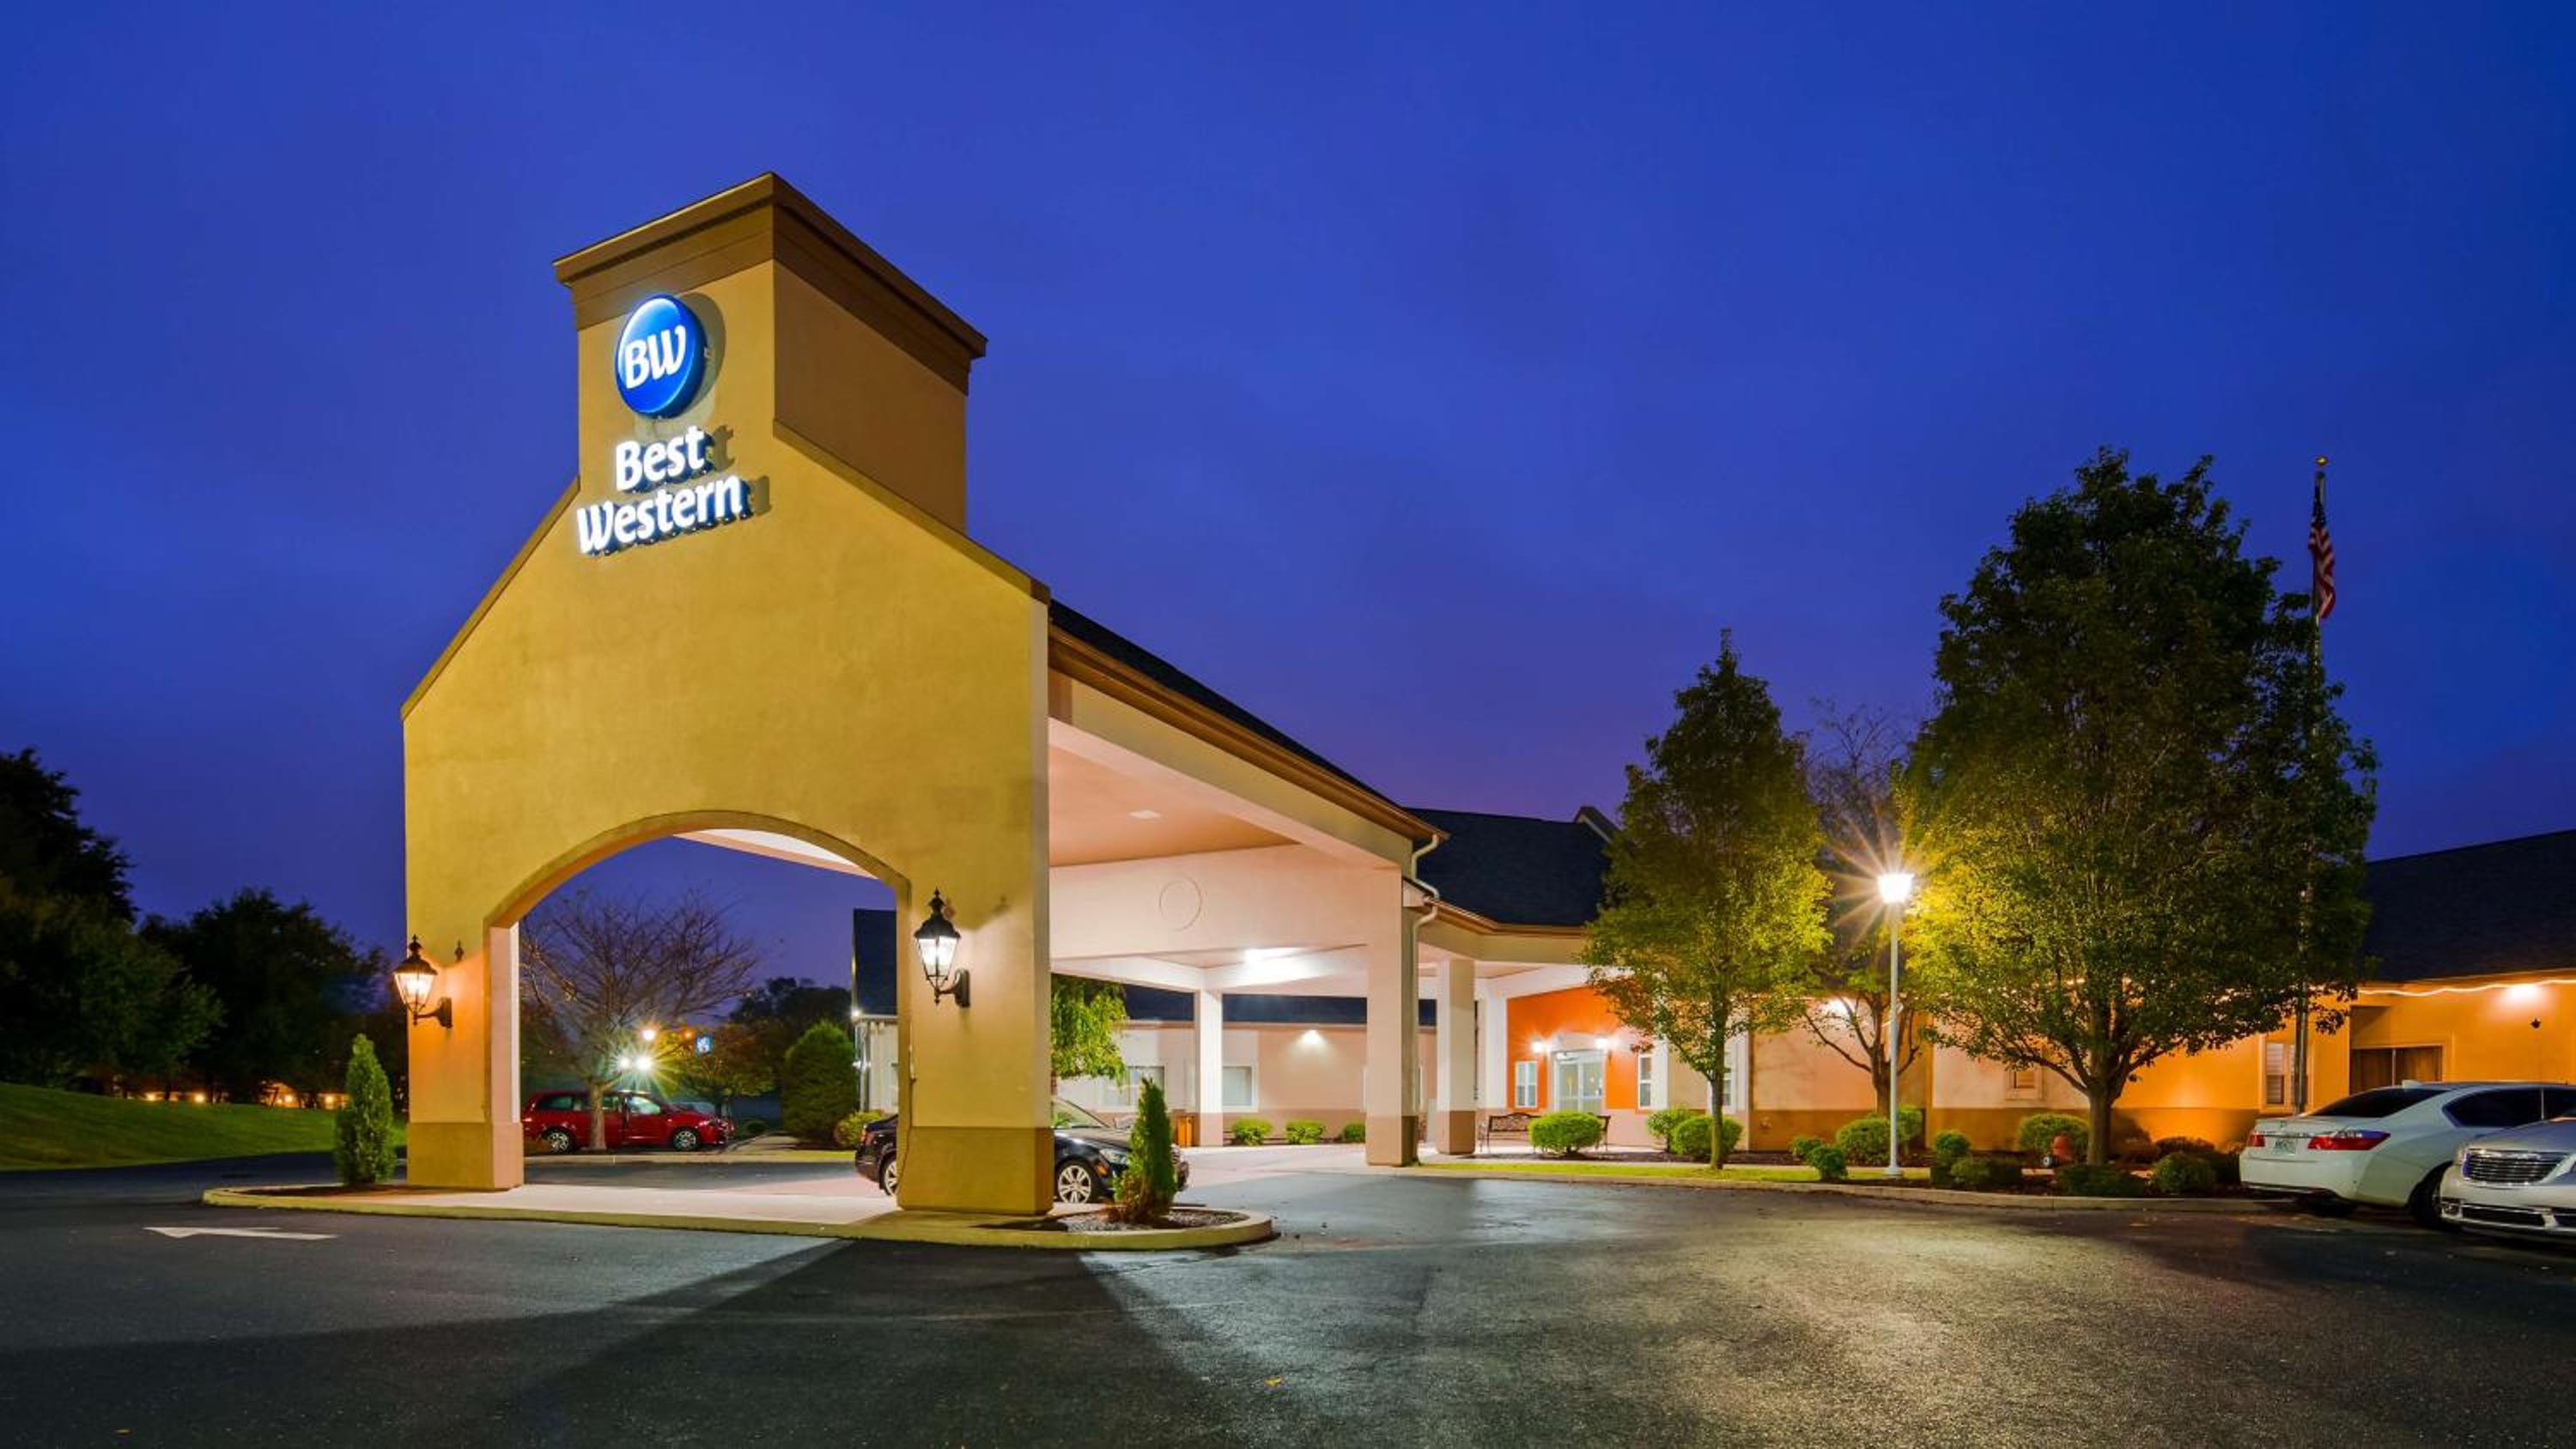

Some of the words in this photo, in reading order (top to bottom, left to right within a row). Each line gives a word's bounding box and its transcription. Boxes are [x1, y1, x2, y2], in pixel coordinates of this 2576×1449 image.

[624, 325, 686, 390] BW
[616, 426, 706, 491] Best
[576, 475, 743, 555] Western
